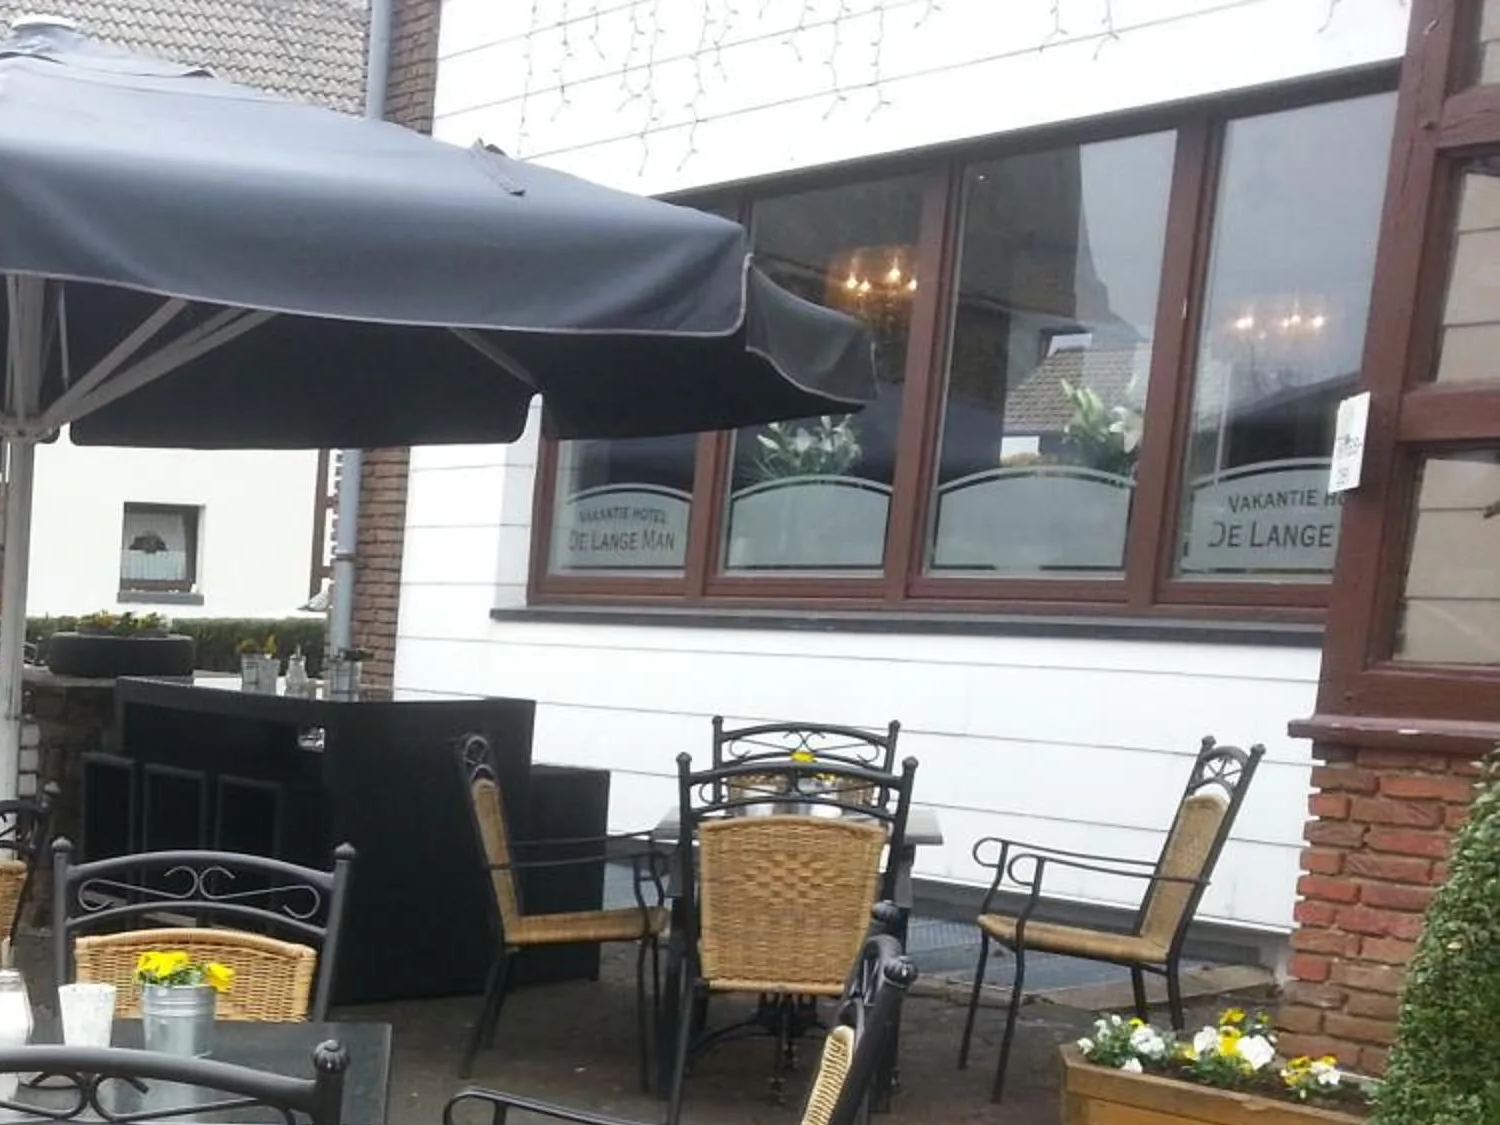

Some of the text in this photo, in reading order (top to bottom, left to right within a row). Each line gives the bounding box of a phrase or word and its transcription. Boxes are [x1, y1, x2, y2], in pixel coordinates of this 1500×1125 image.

[1228, 489, 1318, 512] VAKANTIE
[569, 528, 675, 552] DE LANGE MAN
[1208, 520, 1334, 547] DE LANGE
